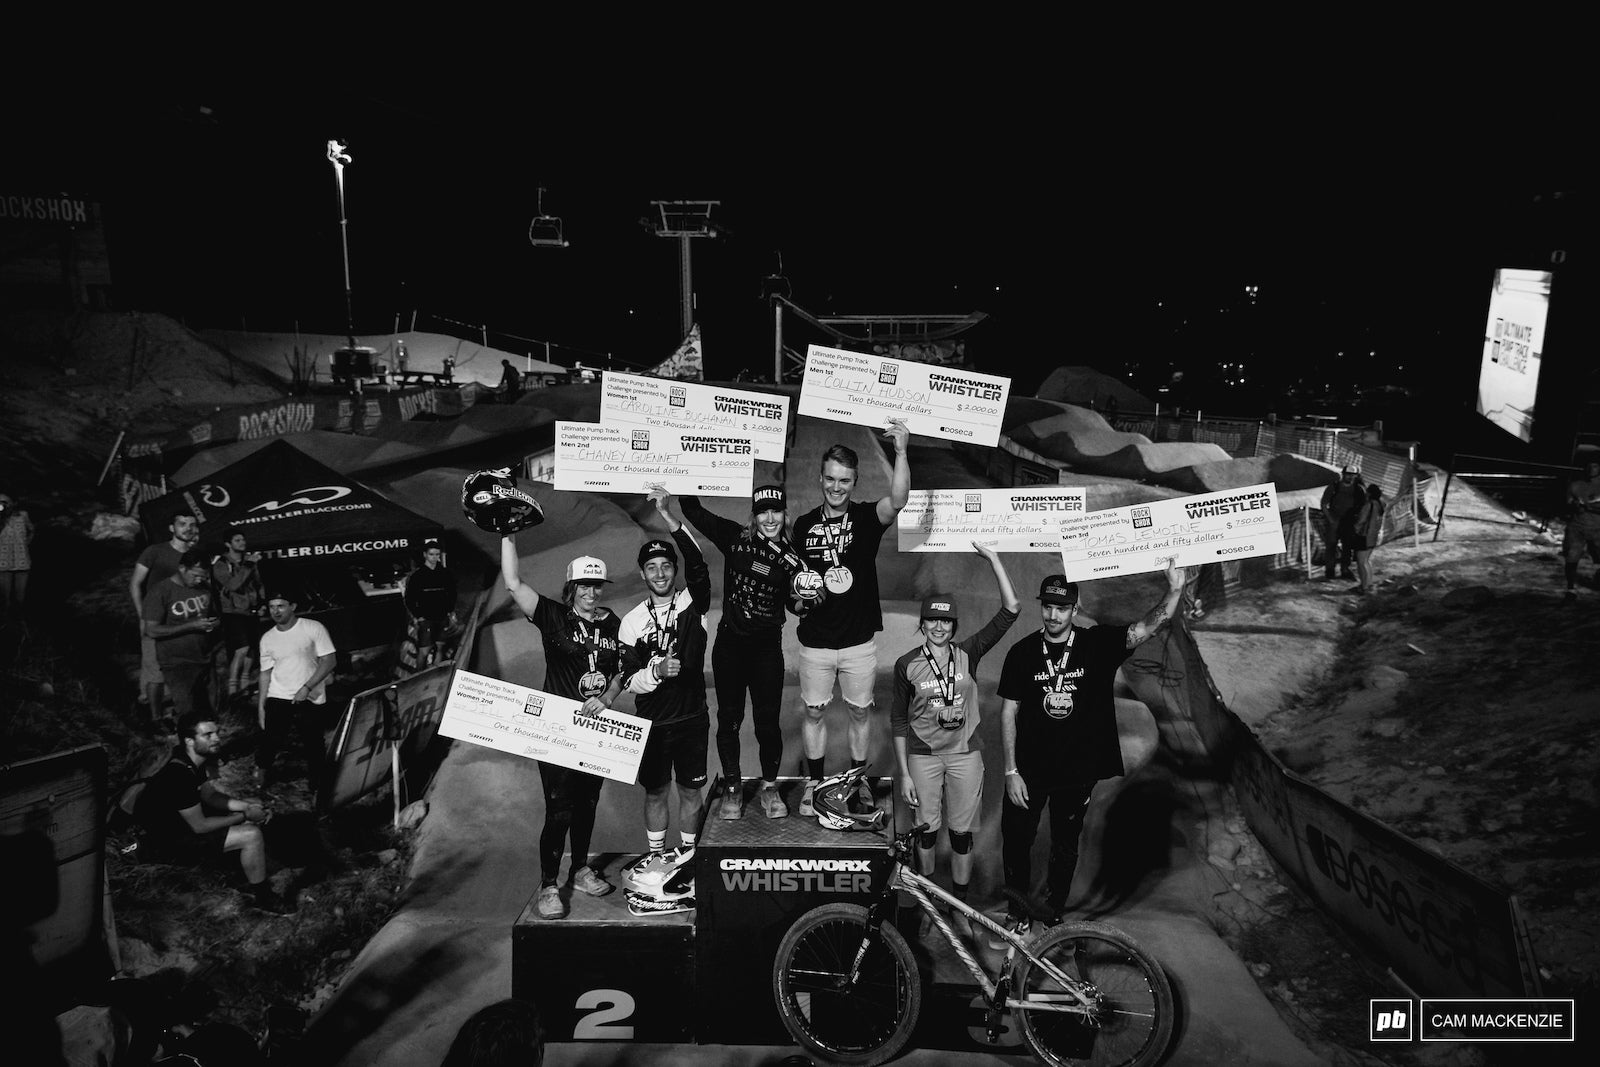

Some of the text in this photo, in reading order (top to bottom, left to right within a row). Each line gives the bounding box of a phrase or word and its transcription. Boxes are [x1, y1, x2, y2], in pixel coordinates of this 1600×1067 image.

[1503, 320, 1533, 343] ULTIMATE
[812, 350, 869, 365] Ultimate Pump Track
[811, 359, 838, 370] Challenge
[839, 363, 868, 374] presented
[881, 364, 898, 374] ROCK
[929, 374, 1002, 390] CRANKWORX
[607, 384, 631, 394] Challenge
[633, 389, 658, 397] presented
[671, 388, 685, 396] ROCK
[824, 376, 931, 404] COLLIN HUDSON
[929, 380, 1001, 401] WHISTLER
[715, 396, 782, 410] CRANKWORX
[848, 394, 932, 415] Two thousand dollars
[621, 401, 681, 417] CAROLINE
[685, 409, 737, 427] BUCHANAN
[715, 402, 782, 420] WHISTLER
[561, 425, 585, 433] Ultimate
[646, 417, 660, 426] Two
[663, 420, 695, 430] thousand
[561, 434, 629, 444] Challenge presented by
[633, 431, 648, 440] ROCK
[681, 436, 751, 444] CRANKWORX
[681, 443, 751, 454] WHISTLER
[578, 450, 626, 462] CHANEY
[624, 465, 660, 474] thousand
[663, 466, 689, 474] dollars
[754, 489, 782, 502] OAKLEY
[1185, 491, 1269, 509] CRANKWORX
[1011, 503, 1082, 511] WHISTLER
[1132, 509, 1149, 518] ROCK
[1186, 500, 1271, 519] WHISTLER
[229, 503, 372, 526] WHISTLER BLACKCOMB
[981, 514, 1022, 524] HINES
[1059, 517, 1083, 525] Ultimate
[1084, 515, 1101, 523] Pump
[998, 526, 1013, 534] fifty
[1061, 524, 1089, 534] Challenge
[1090, 520, 1120, 530] presented
[1227, 522, 1232, 530] $
[806, 538, 818, 546] FLY
[1080, 522, 1200, 548] TOMAS LEMOINE
[315, 538, 408, 555] BLACKCOMB
[1088, 533, 1224, 558] Seven hundred and fifty dollars
[1034, 671, 1050, 681] ride
[461, 676, 515, 694] Ultimate Pump Track
[456, 691, 480, 702] Women
[458, 684, 523, 706] Challenge presented by
[574, 709, 643, 732] CANKWORX
[494, 721, 577, 749] One thousand dollars
[572, 716, 642, 742] WHISTLER
[598, 740, 603, 748] $
[719, 858, 873, 873] CRANKWORX
[723, 872, 873, 894] WHISTLER
[573, 988, 636, 1040] 2
